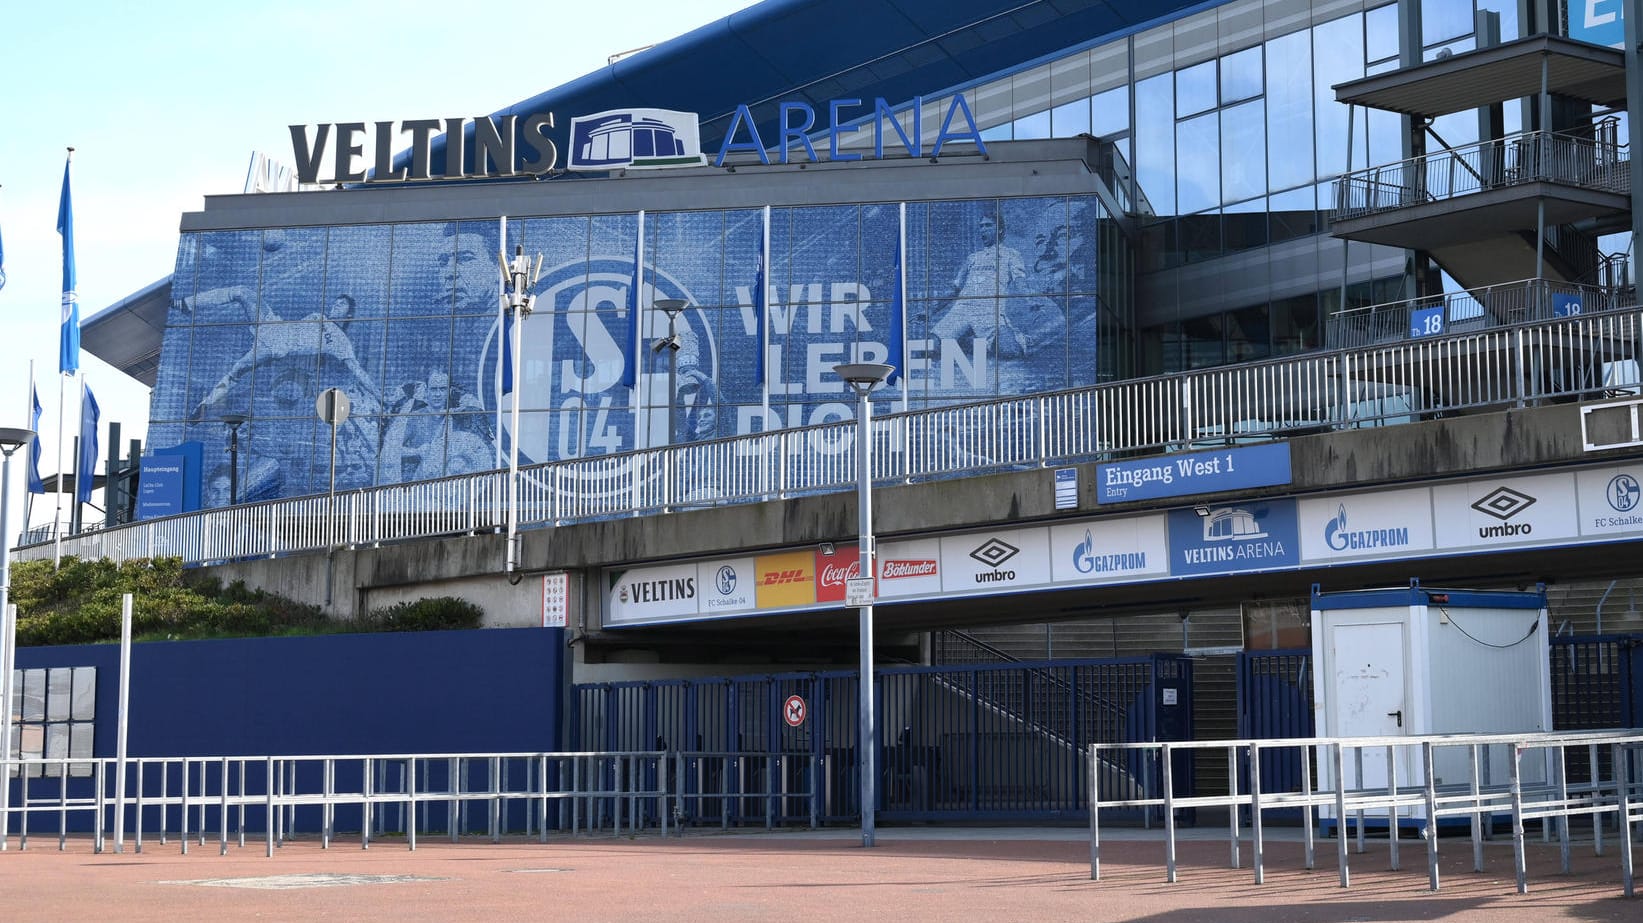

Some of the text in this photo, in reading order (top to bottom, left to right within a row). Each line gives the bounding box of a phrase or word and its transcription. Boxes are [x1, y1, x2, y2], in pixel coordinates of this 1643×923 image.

[288, 112, 556, 184] VELTINS
[714, 93, 988, 167] ARENA
[735, 282, 873, 336] WIR
[1411, 314, 1442, 337] Th 18
[1105, 454, 1234, 487] Eingang West 1
[1106, 487, 1128, 498] Entry
[1479, 521, 1532, 539] umbro
[1595, 515, 1643, 528] FC Schalke
[1350, 527, 1408, 549] GAZPROM
[1095, 552, 1146, 572] GAZPROM
[1184, 541, 1285, 565] VELTINS ARENA
[763, 569, 805, 585] DHL
[975, 569, 1016, 583] umbro
[631, 577, 695, 604] VELTINS
